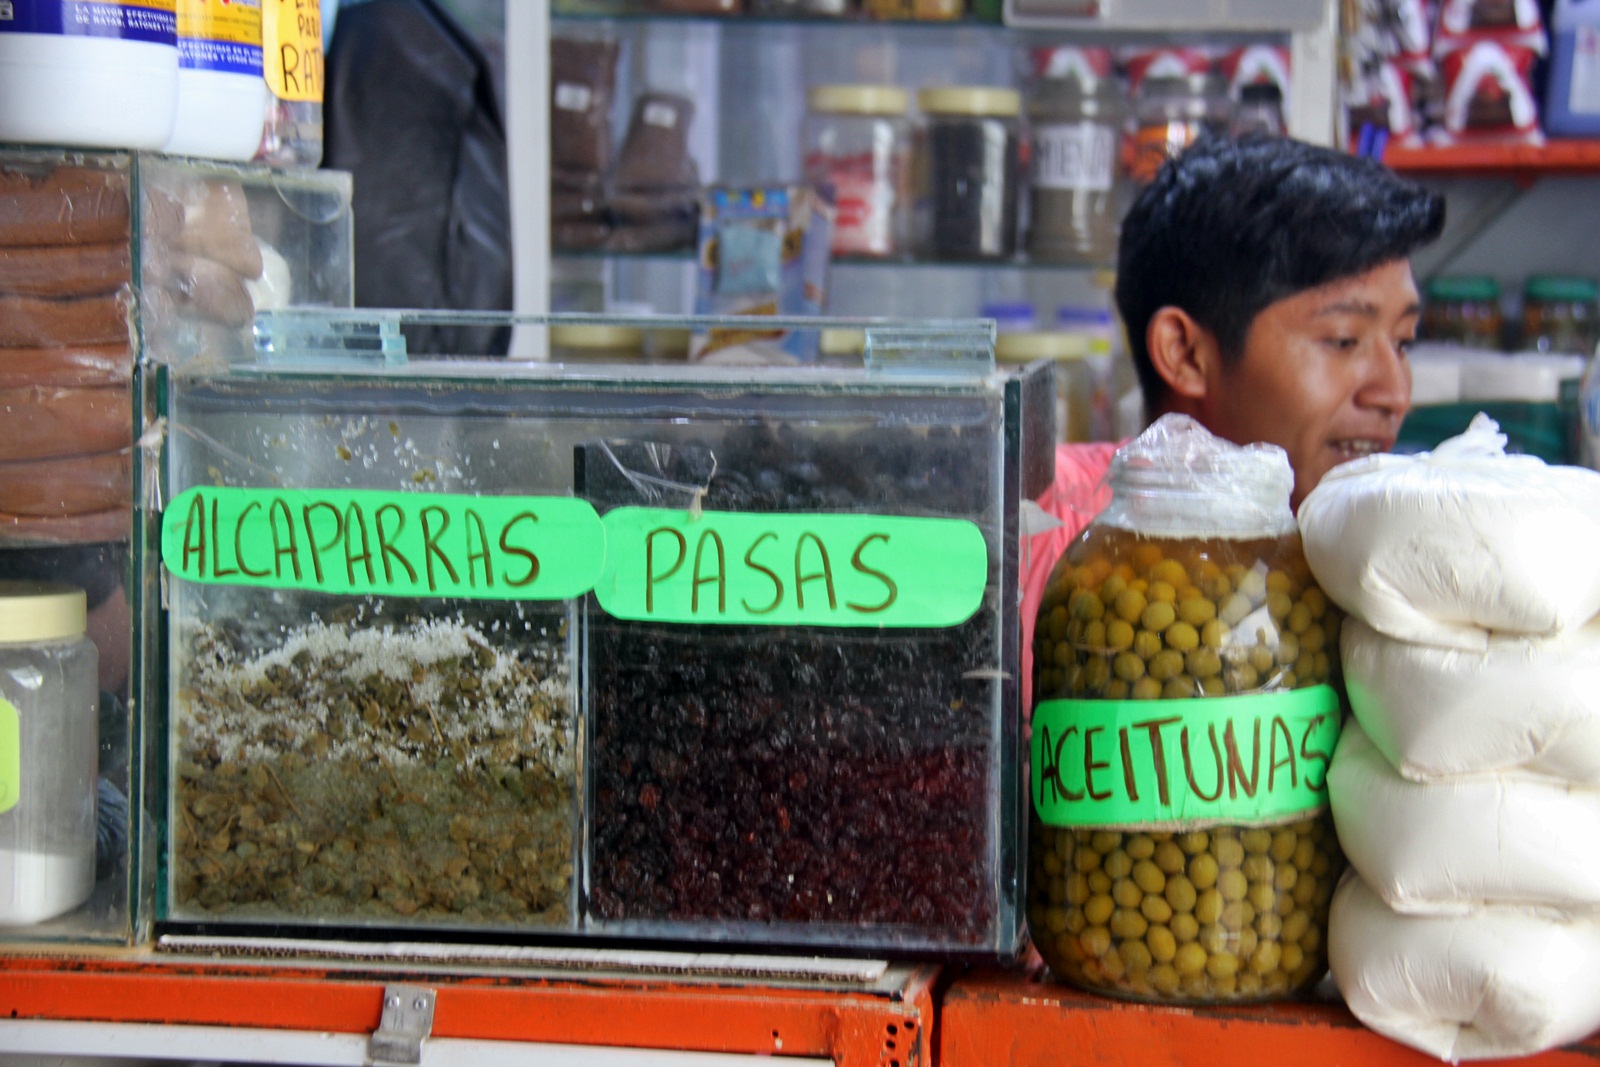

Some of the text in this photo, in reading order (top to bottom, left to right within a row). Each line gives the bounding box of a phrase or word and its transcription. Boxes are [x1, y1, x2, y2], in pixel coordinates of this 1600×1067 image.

[75, 4, 89, 15] LA
[93, 6, 124, 18] MAYOR
[75, 14, 89, 24] DE
[181, 493, 538, 590] ALCAPARRAS
[646, 525, 900, 614] PASAS
[1039, 715, 1329, 807] ACEITUNAS
